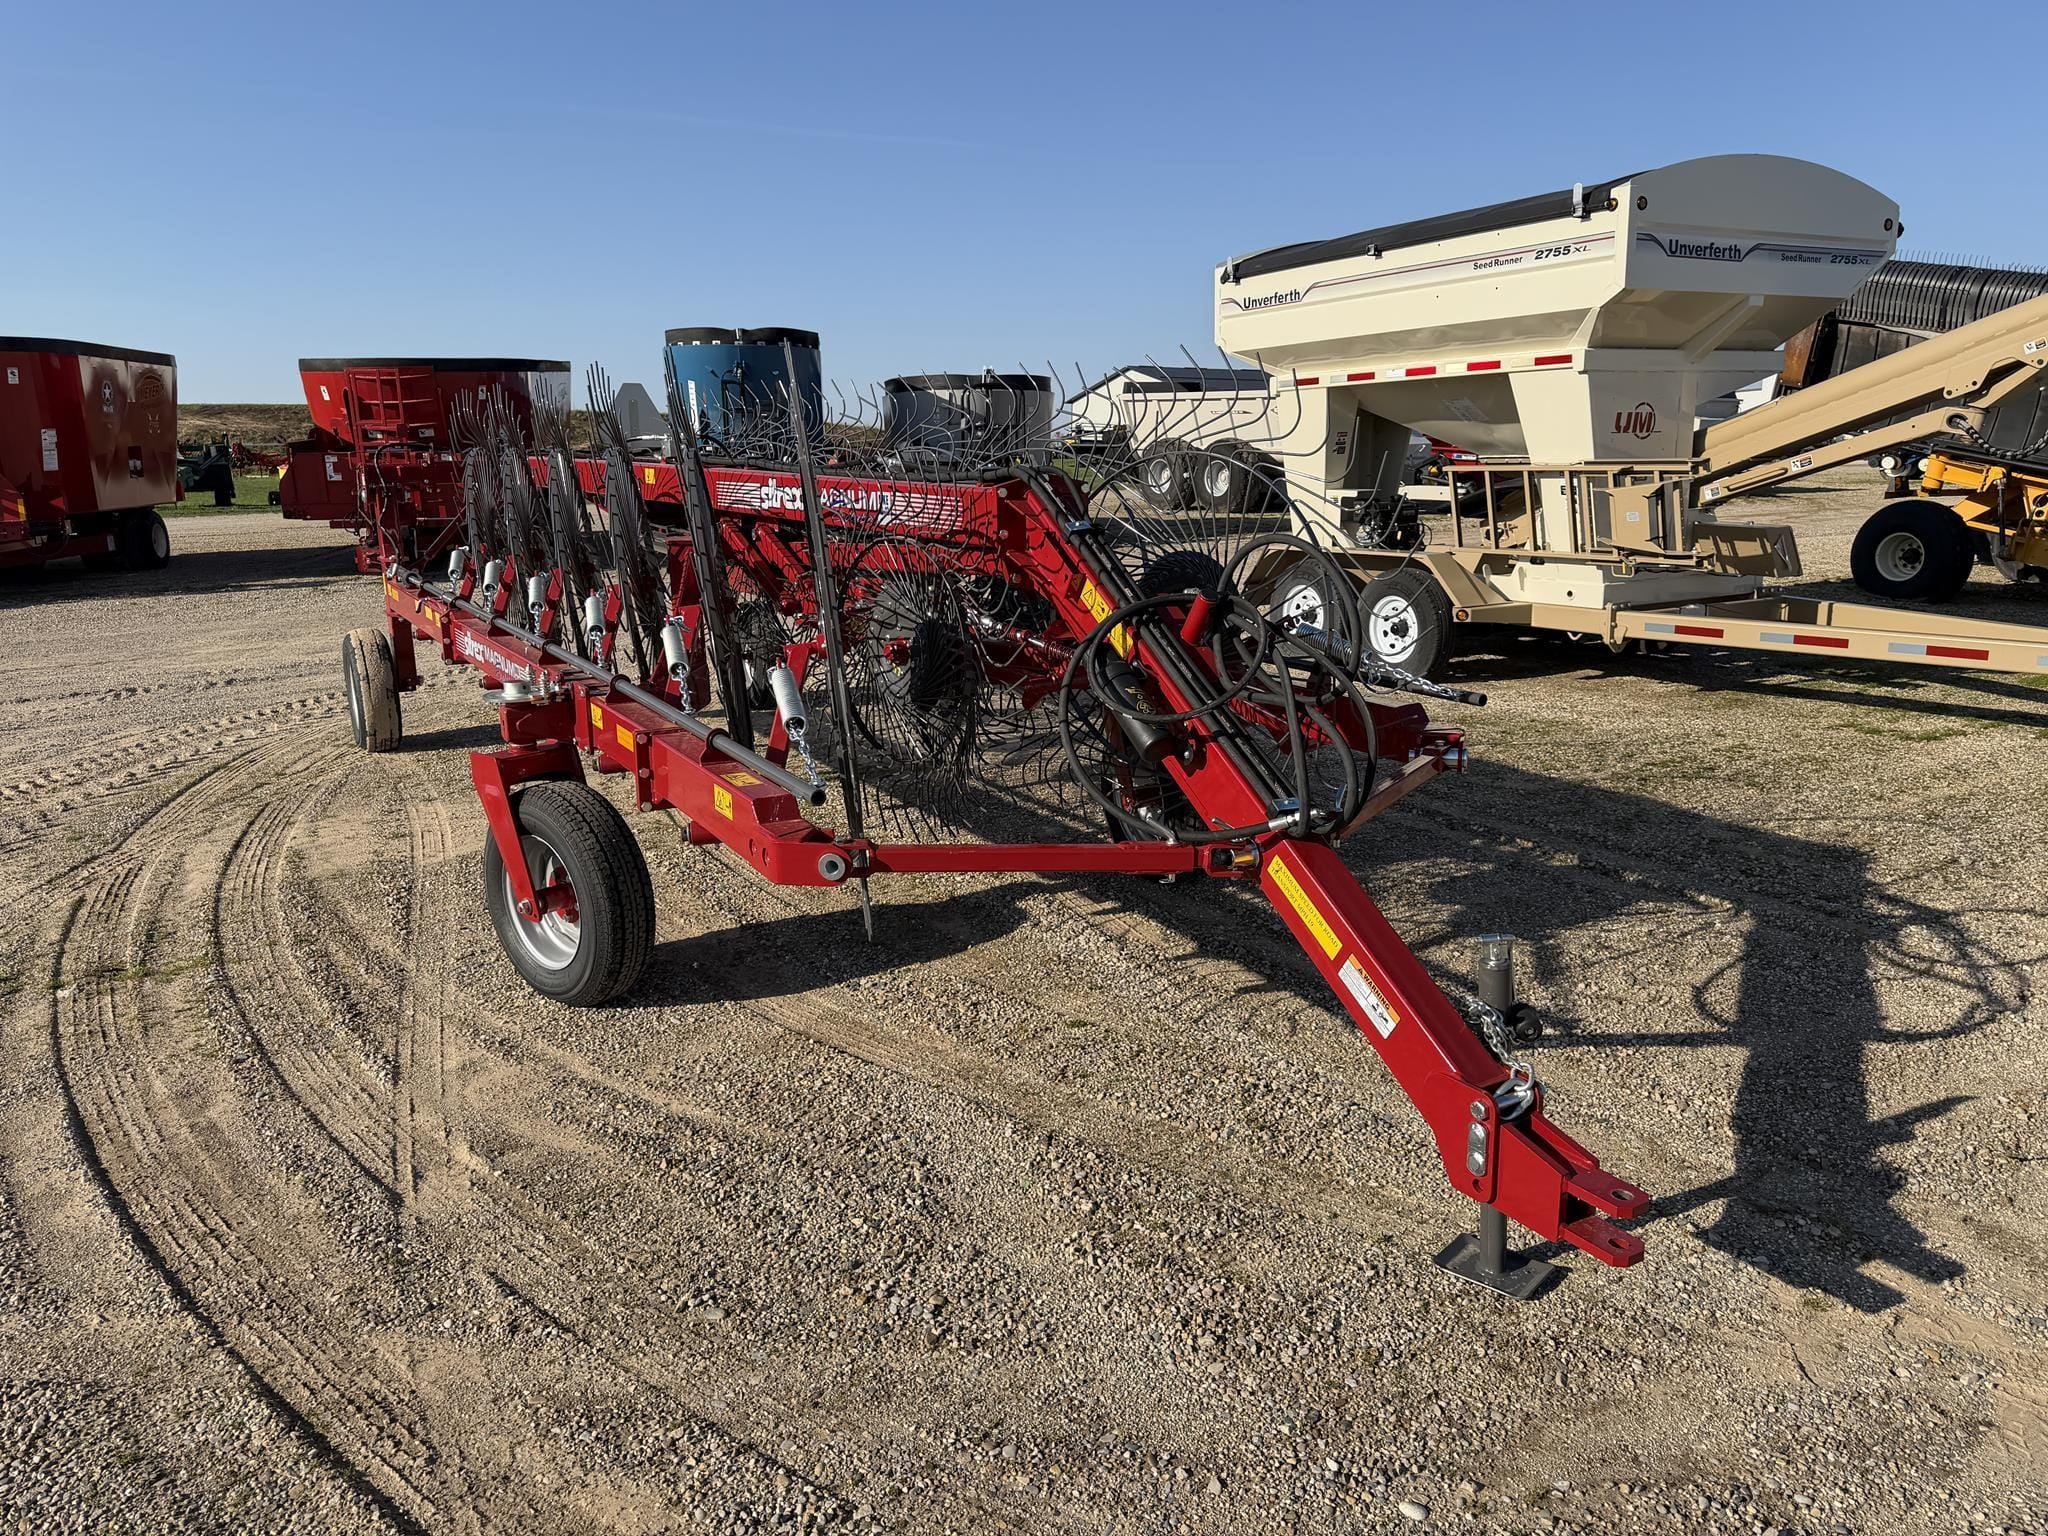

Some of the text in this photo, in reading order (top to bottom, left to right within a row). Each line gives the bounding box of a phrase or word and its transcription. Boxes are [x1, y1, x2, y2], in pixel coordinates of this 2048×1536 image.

[1668, 239, 1741, 260] Unverferth
[1243, 288, 1301, 309] Unverferth
[1363, 973, 1391, 1011] WARNING
